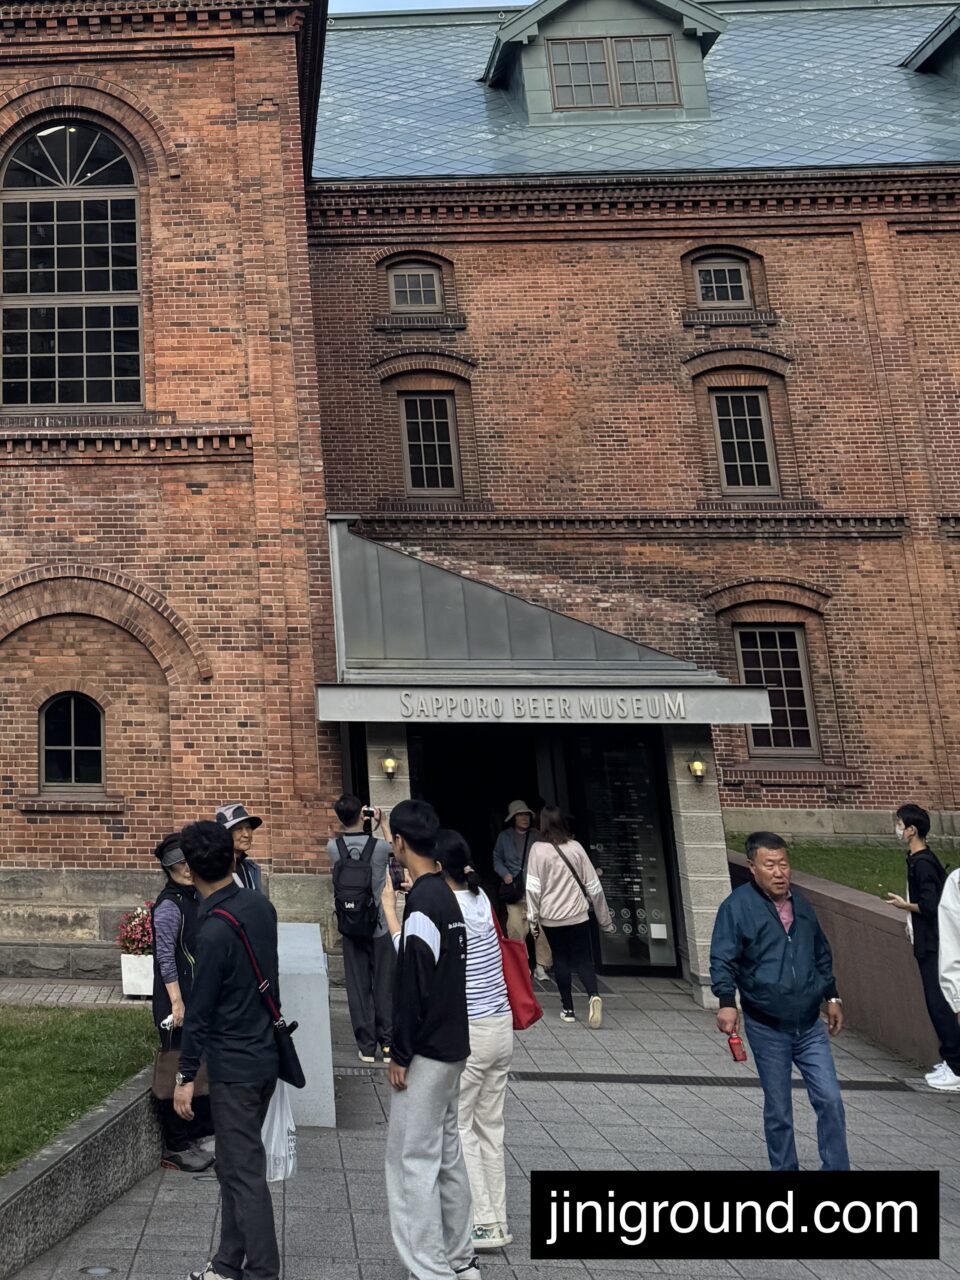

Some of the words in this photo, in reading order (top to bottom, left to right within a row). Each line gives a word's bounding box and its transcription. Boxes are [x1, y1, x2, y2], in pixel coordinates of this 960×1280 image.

[400, 690, 504, 718] SAPPORO
[512, 696, 572, 719] BEER
[578, 692, 687, 719] MUSEUM
